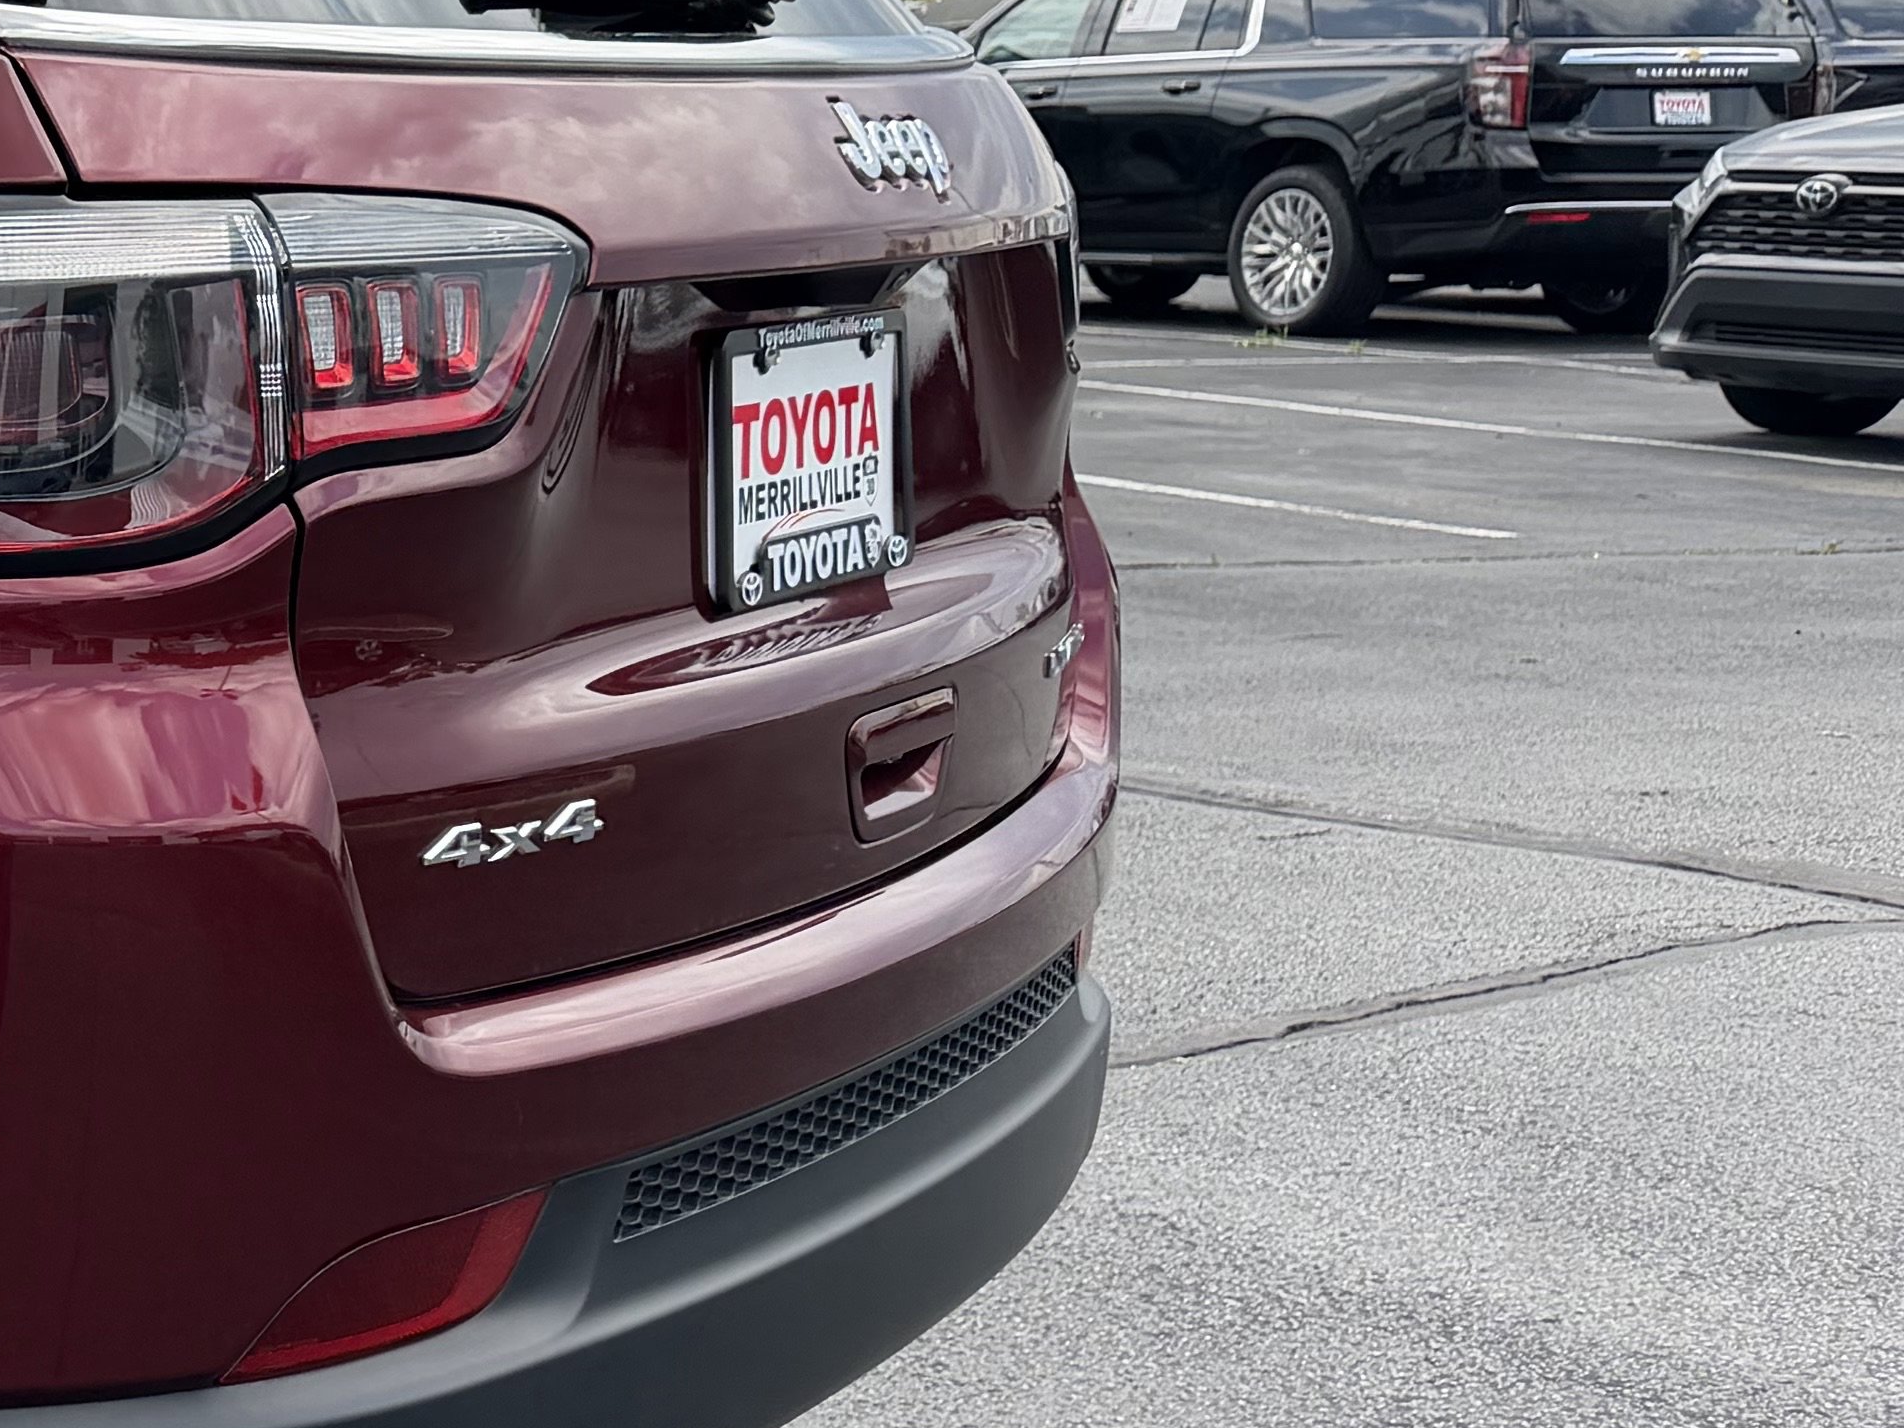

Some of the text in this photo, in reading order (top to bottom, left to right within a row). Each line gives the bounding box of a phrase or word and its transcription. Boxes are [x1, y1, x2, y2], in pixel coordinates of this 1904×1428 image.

[828, 98, 951, 199] Jeep
[733, 383, 879, 480] TOYOTA
[739, 463, 861, 525] MERRILLVILLE
[767, 525, 865, 591] TOYOTA
[422, 798, 605, 868] 4x4
